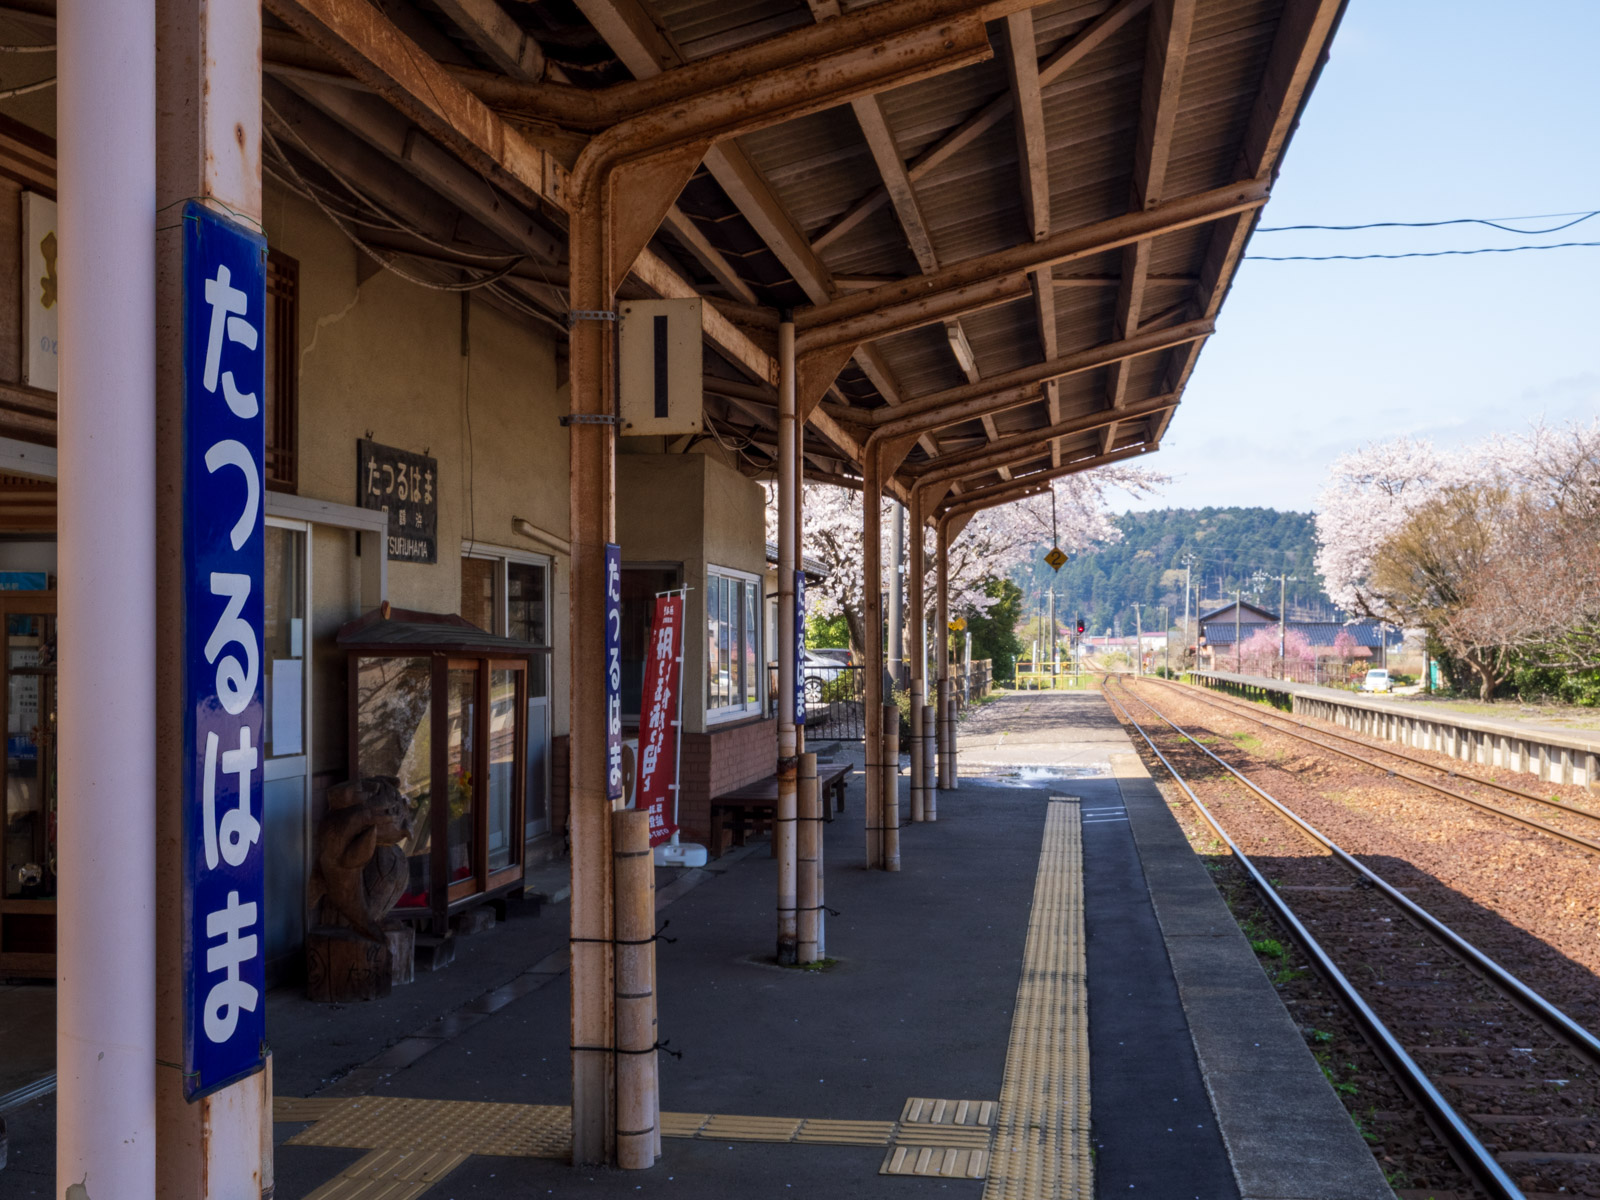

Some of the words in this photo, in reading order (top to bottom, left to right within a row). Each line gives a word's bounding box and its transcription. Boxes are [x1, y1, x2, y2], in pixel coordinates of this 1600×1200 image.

[368, 455, 433, 505] たつるはま
[1051, 551, 1061, 565] 2
[203, 264, 261, 1044] たつるはま
[608, 557, 621, 786] たつるはま
[796, 579, 805, 717] たつるはま
